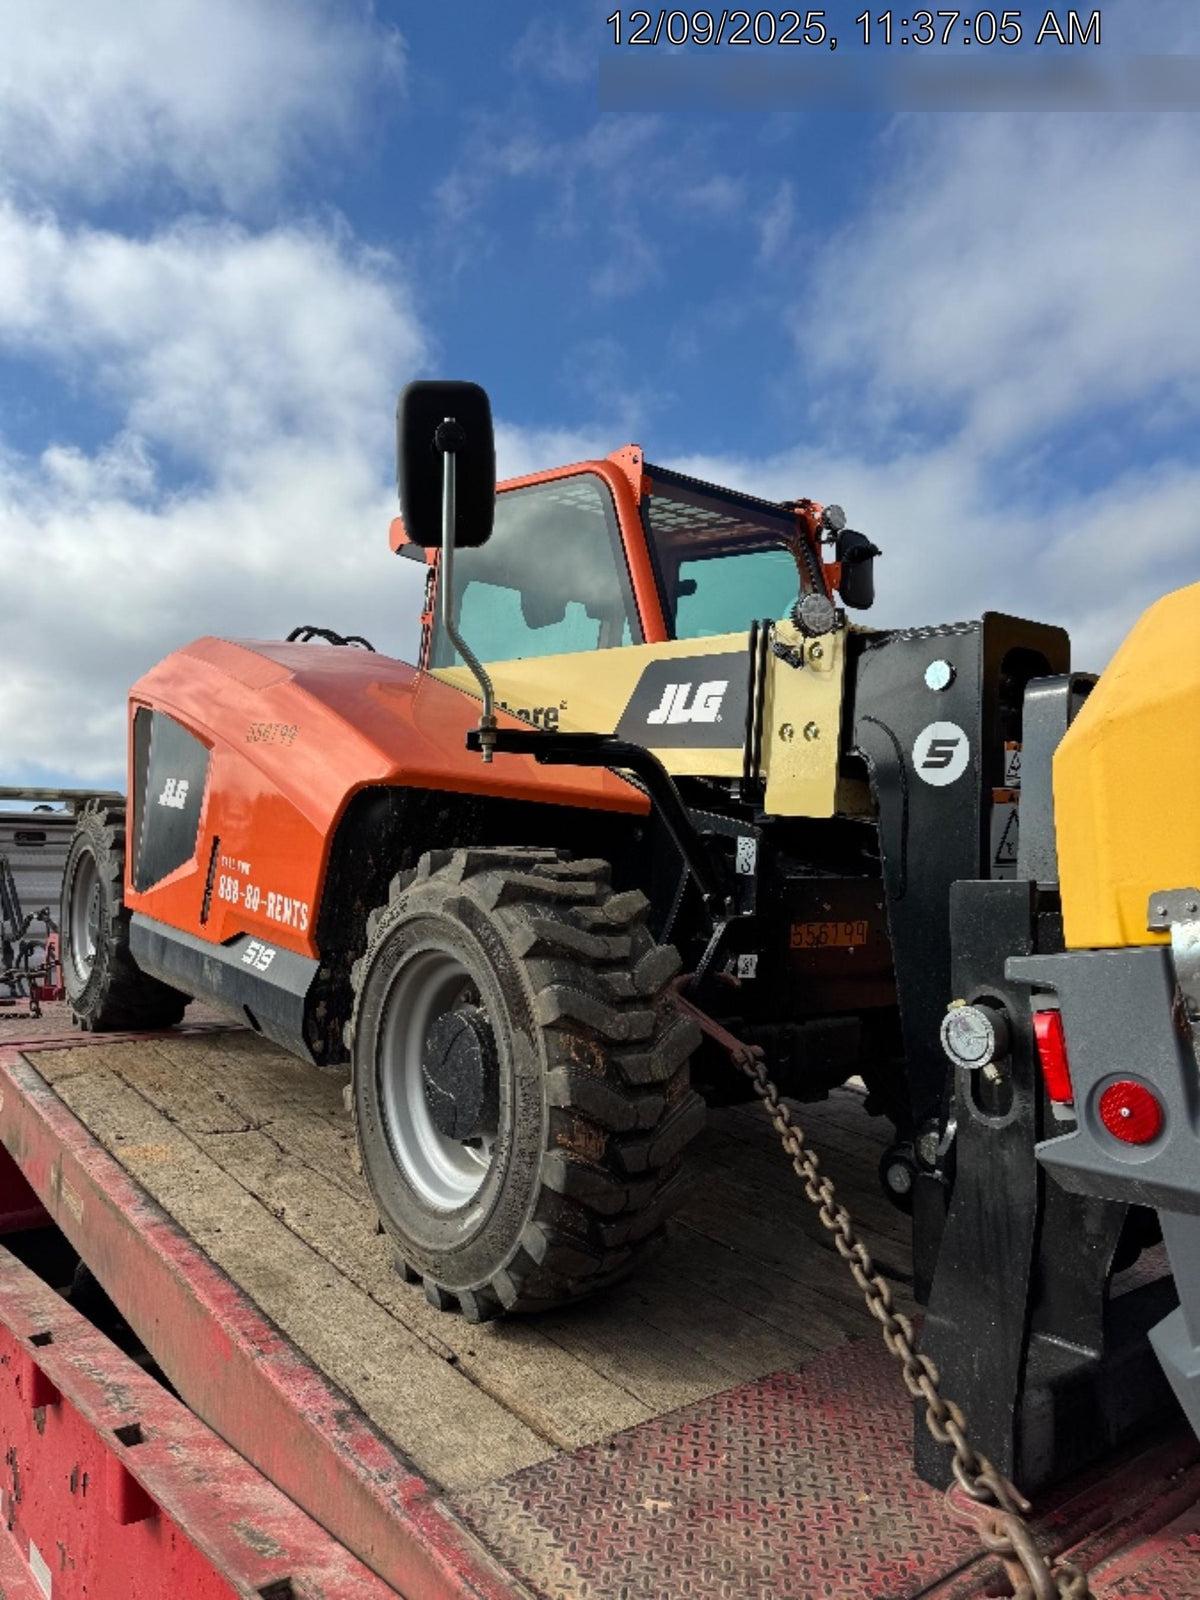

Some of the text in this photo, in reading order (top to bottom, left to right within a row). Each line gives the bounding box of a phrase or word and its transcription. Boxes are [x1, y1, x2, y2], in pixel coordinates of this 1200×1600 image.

[646, 680, 730, 724] JLG
[157, 778, 190, 810] JLG
[218, 874, 309, 931] 888-80-RENTS
